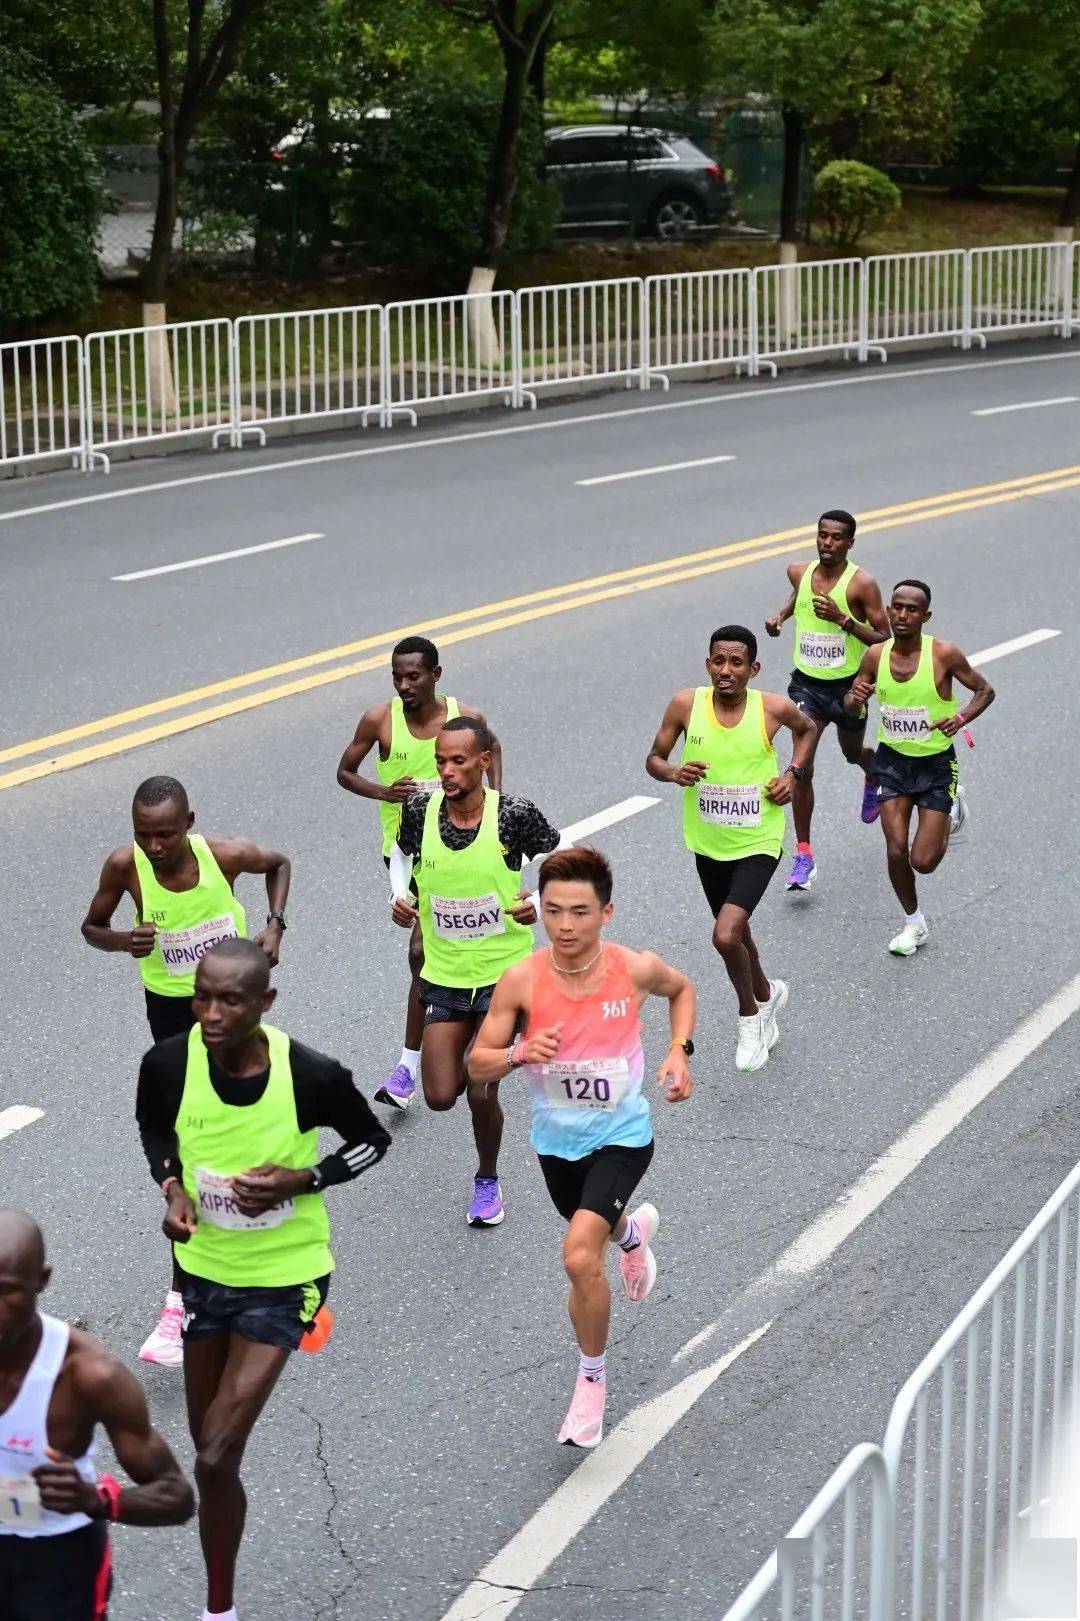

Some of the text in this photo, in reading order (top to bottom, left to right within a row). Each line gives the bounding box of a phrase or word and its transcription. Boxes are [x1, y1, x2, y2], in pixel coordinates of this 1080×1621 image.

[800, 644, 845, 658] MEKONEN
[882, 717, 930, 732] GIRMA
[699, 797, 760, 816] BIRHANU
[434, 908, 500, 929] TSEGAY
[561, 1078, 610, 1102] 120
